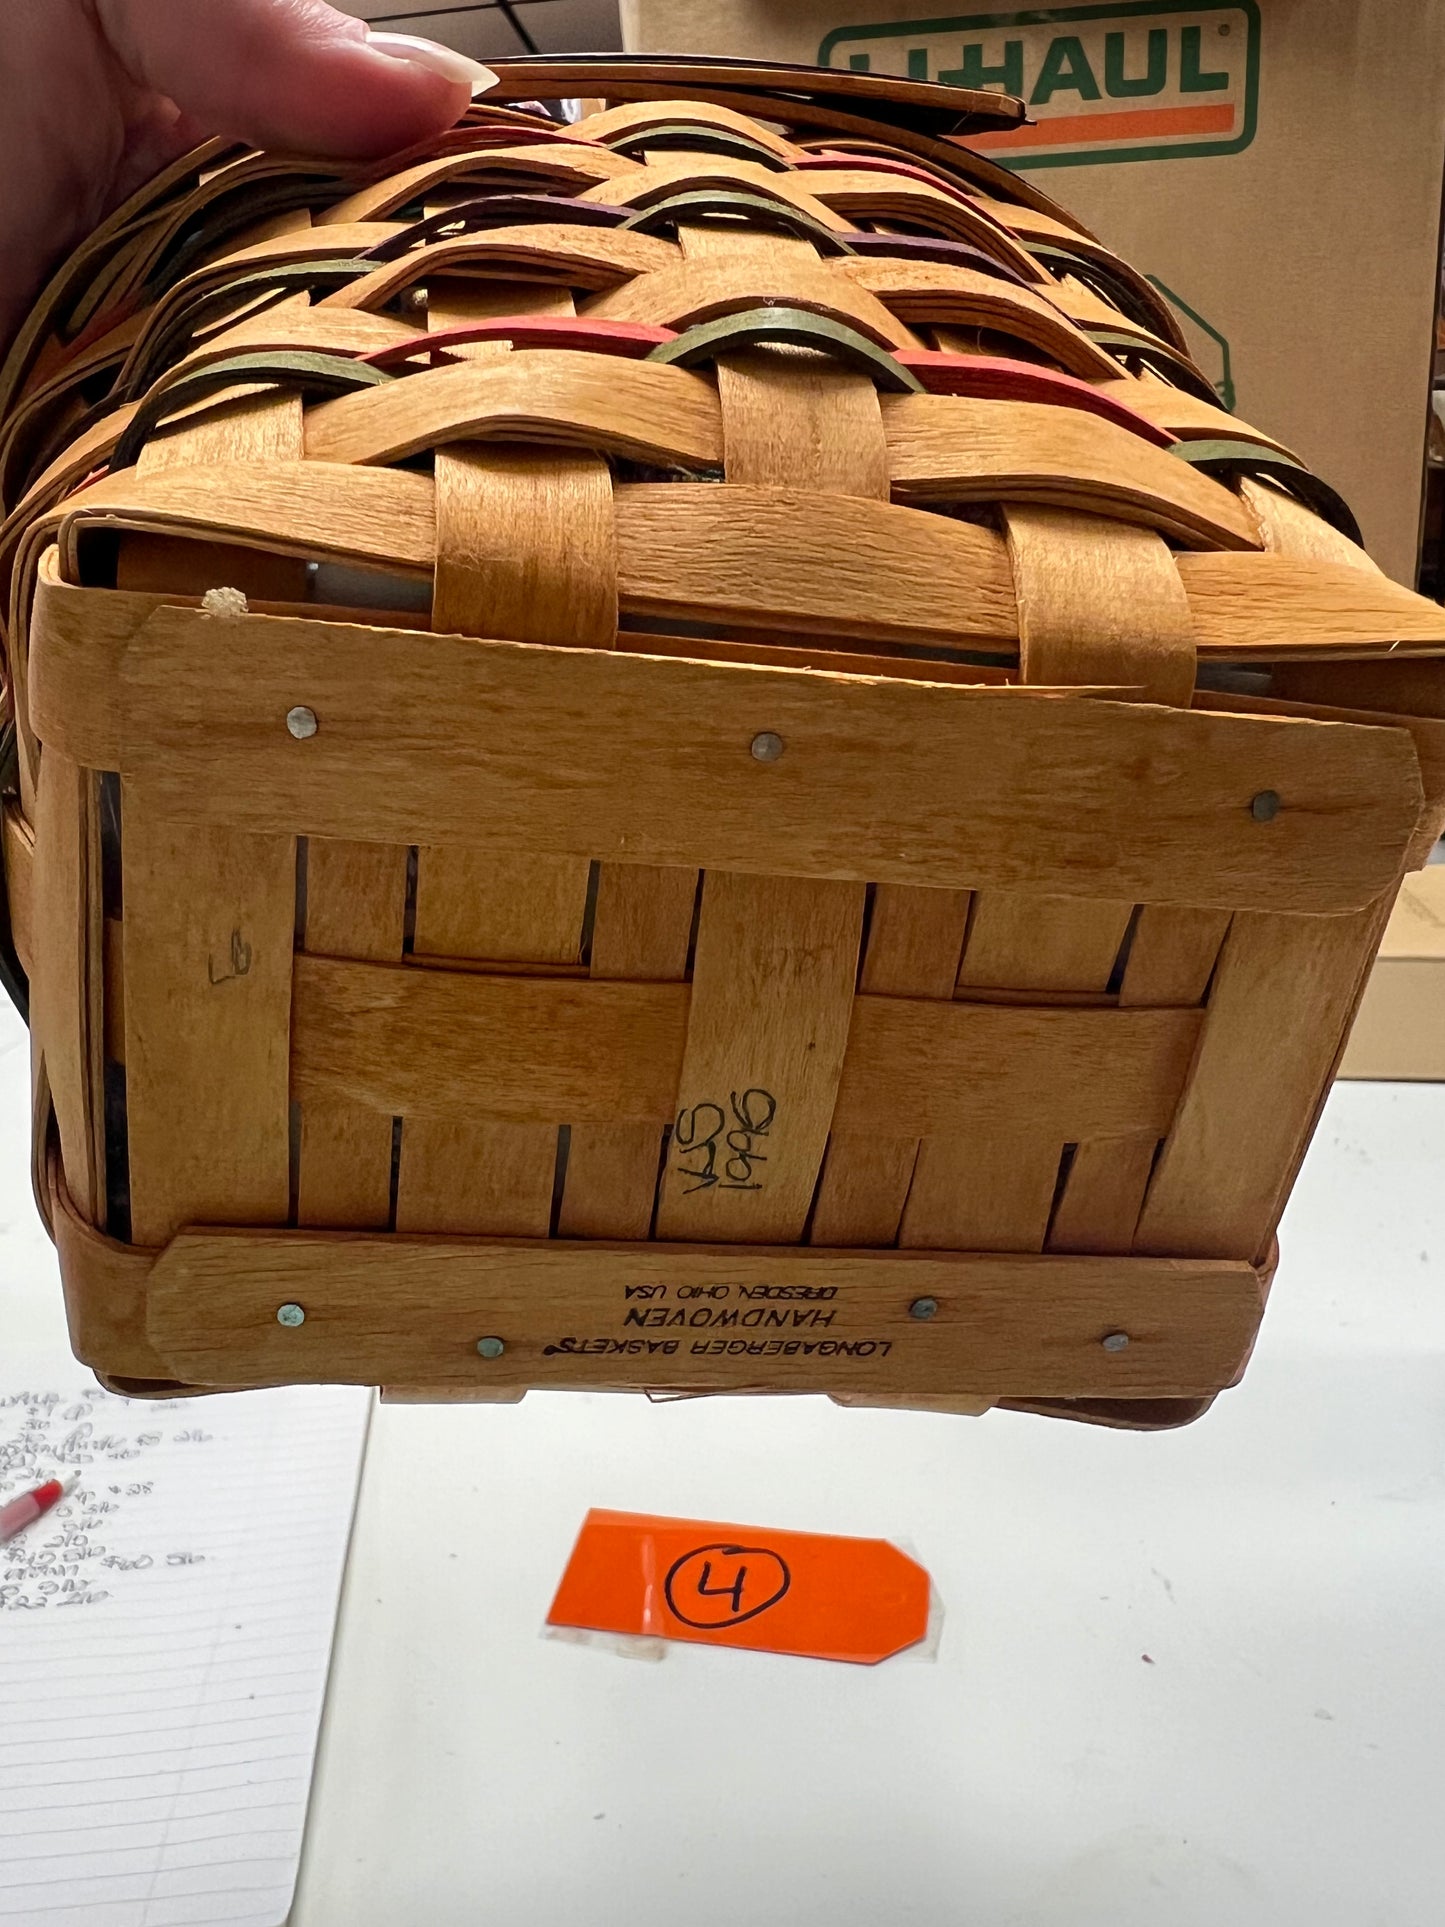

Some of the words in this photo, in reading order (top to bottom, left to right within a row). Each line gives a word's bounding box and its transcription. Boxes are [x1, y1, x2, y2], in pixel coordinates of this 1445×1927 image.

[625, 1285, 666, 1299] USA
[677, 1286, 729, 1299] OHIO
[623, 1307, 837, 1328] HANDWOVEN
[543, 1336, 680, 1356] BASKETS
[690, 1338, 893, 1357] LONGABERGER
[697, 1560, 748, 1613] 4
